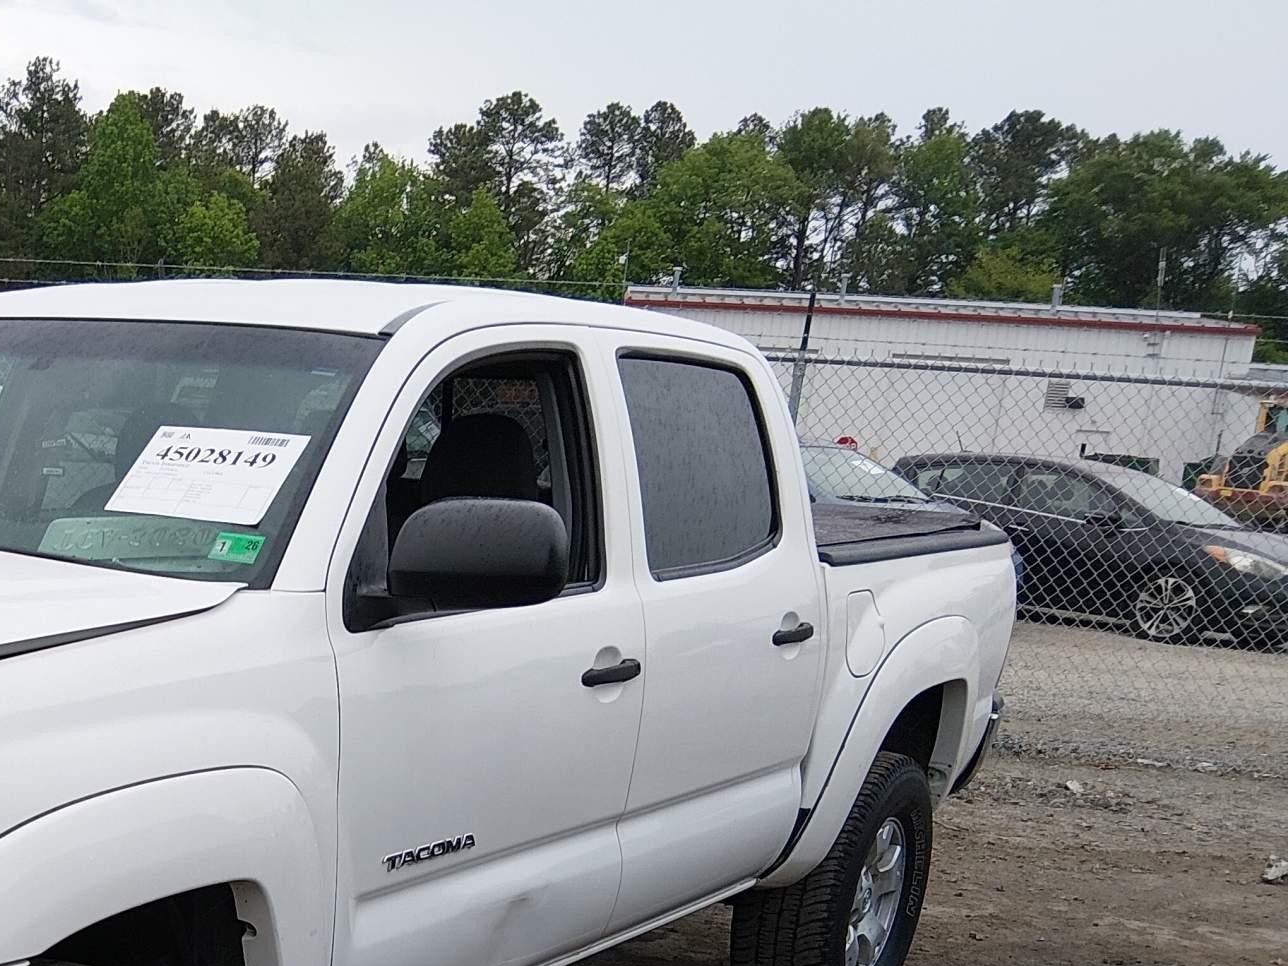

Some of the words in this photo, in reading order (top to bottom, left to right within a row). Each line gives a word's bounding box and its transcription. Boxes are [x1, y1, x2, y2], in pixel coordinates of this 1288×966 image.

[156, 444, 277, 469] 45028149
[245, 540, 260, 551] 26
[382, 833, 476, 872] TACOMA
